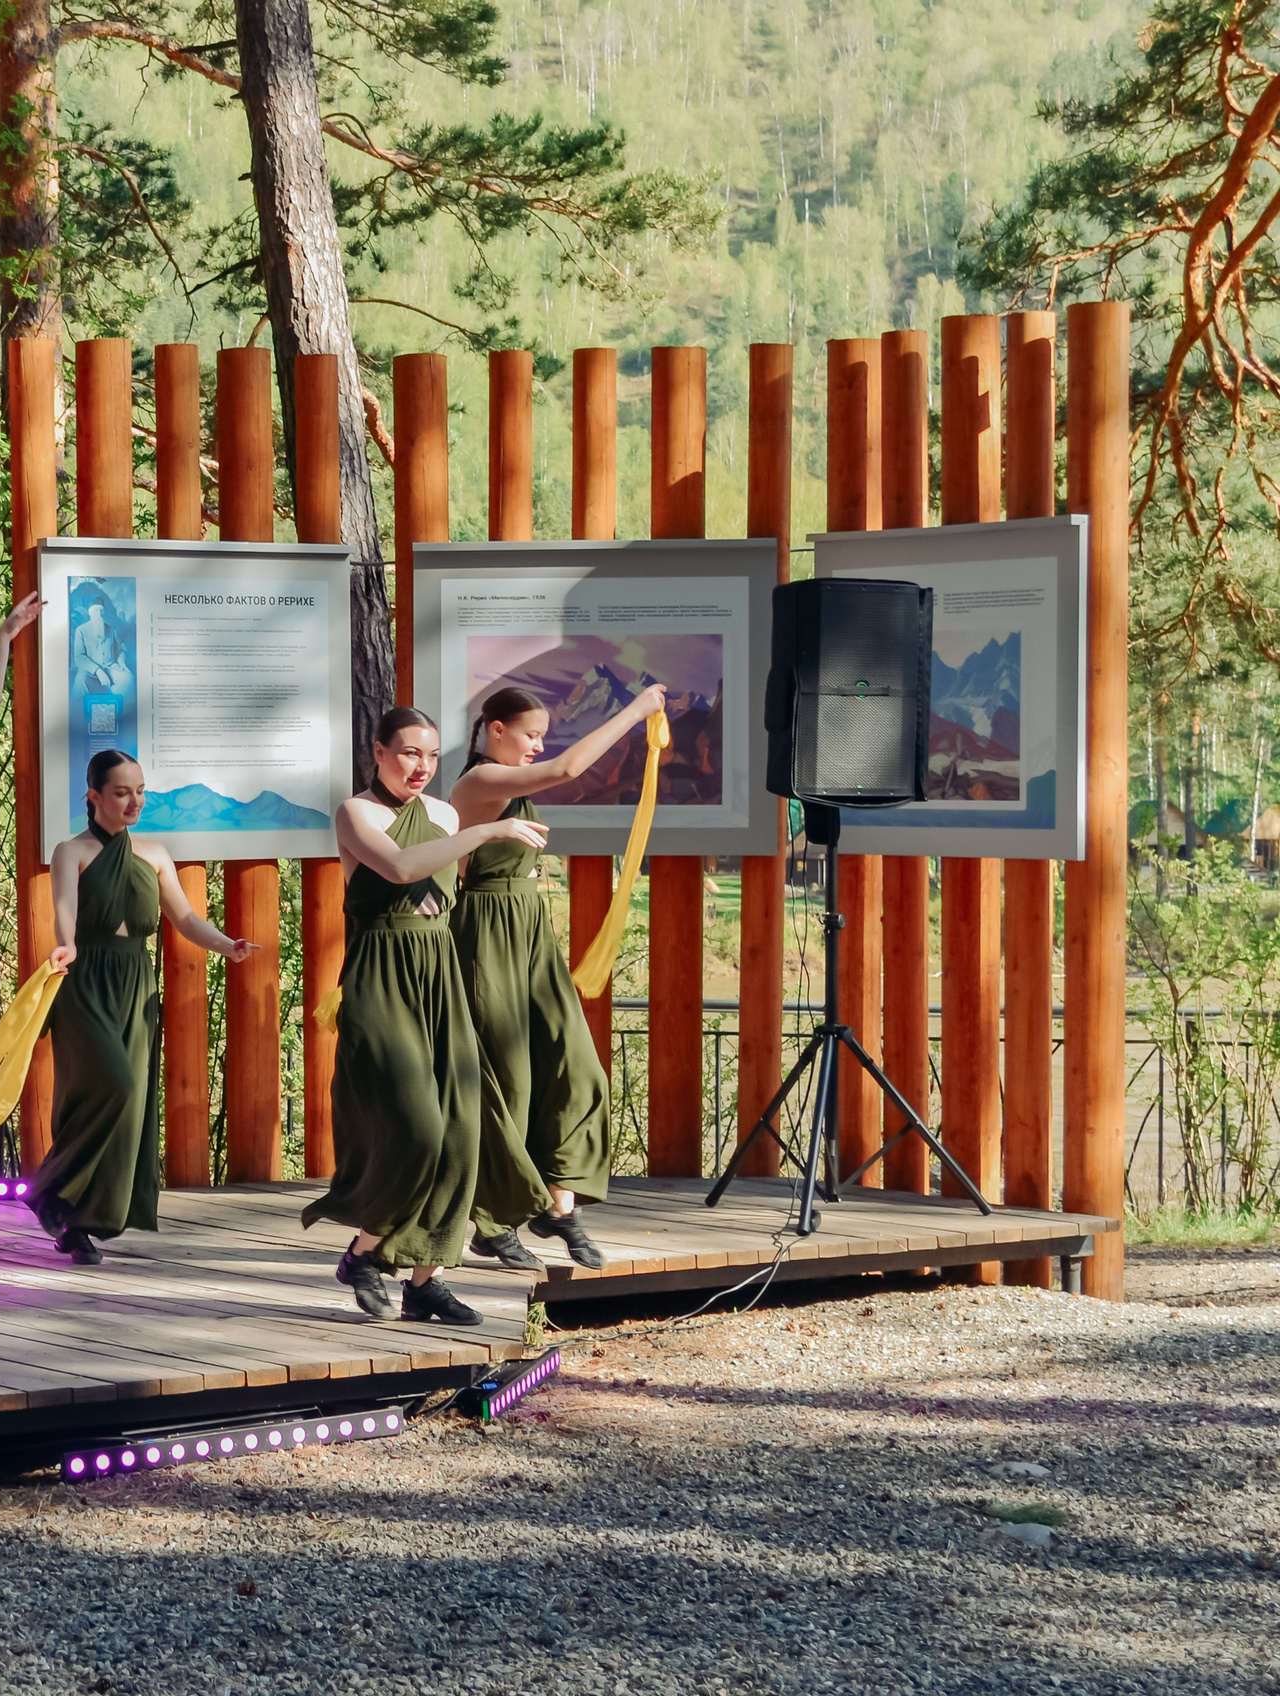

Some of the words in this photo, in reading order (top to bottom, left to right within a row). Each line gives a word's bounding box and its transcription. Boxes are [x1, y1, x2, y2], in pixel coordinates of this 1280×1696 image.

[164, 594, 224, 606] НЕСКОЛЬКО
[226, 595, 267, 606] ФАКТОВ
[268, 596, 276, 606] О
[278, 596, 315, 607] РЕРИХЕ
